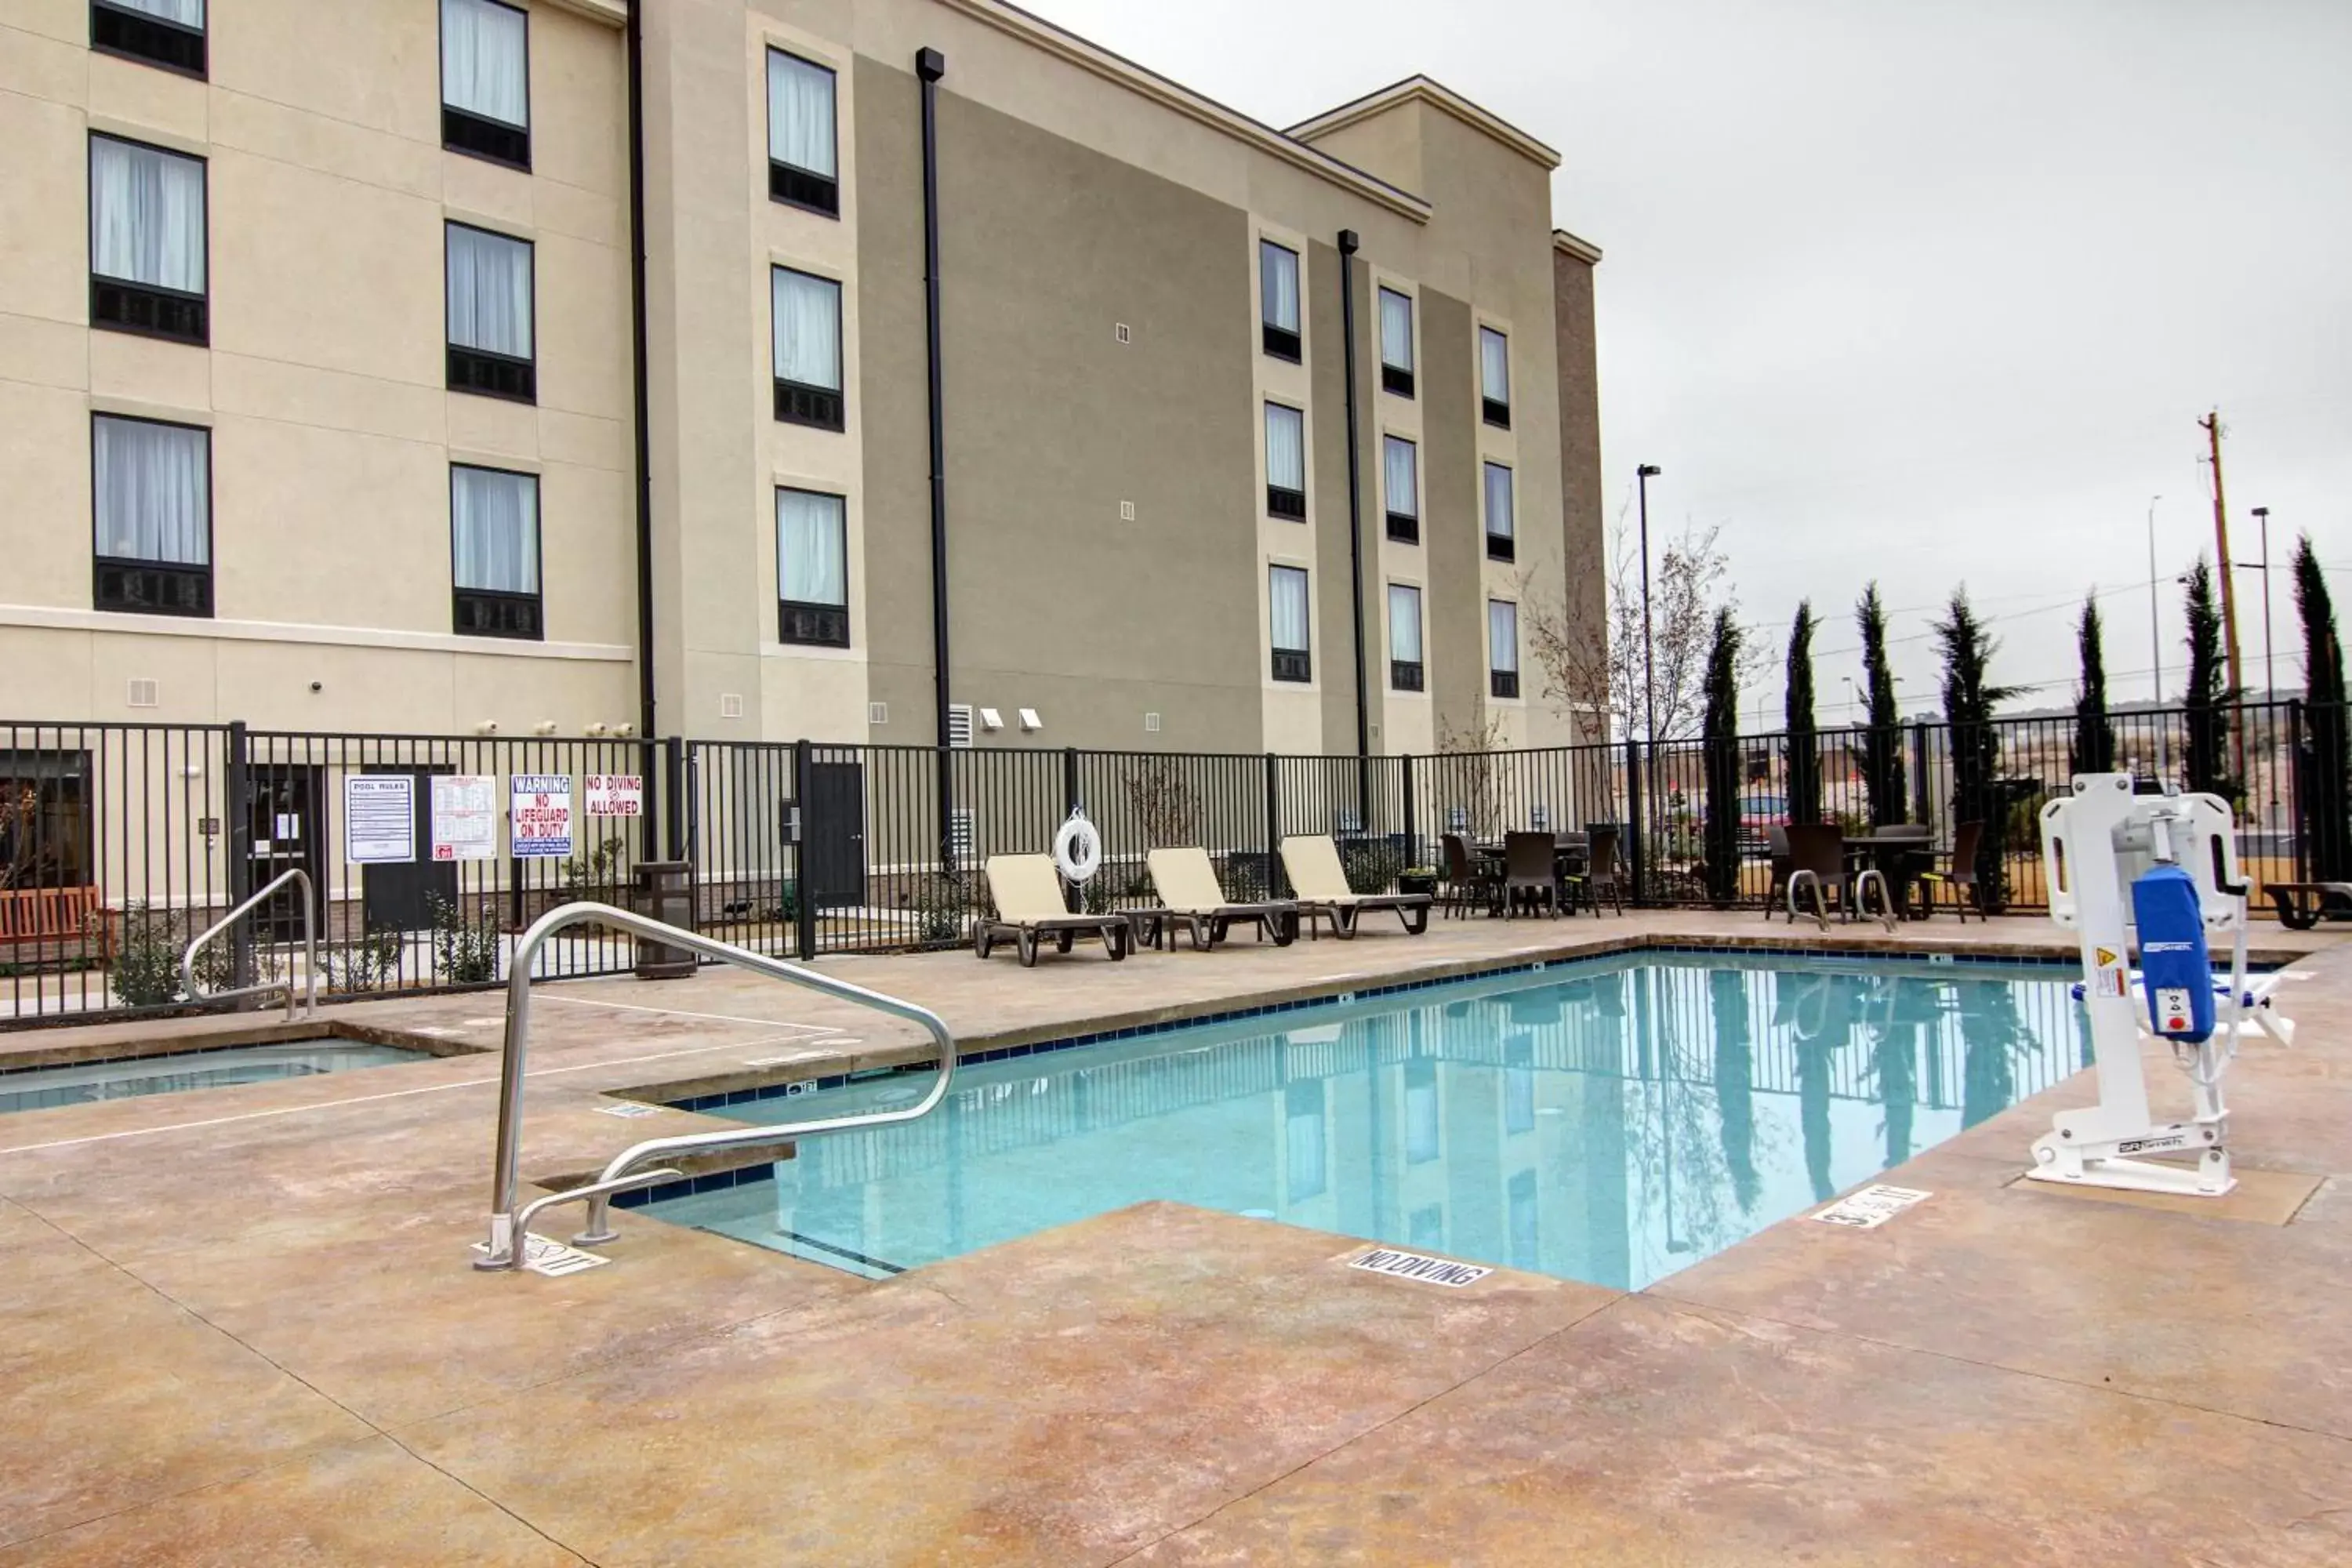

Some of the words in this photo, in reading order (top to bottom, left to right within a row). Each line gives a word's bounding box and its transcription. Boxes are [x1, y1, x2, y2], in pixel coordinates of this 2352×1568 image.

[514, 777, 569, 793] WARNING
[587, 776, 601, 791] NO
[607, 777, 641, 791] DIVING
[535, 794, 550, 808] NO
[590, 800, 638, 815] ALLOWED
[515, 808, 568, 822] LIFEGUARD
[521, 823, 534, 837] ON
[539, 823, 564, 837] DUTY
[1353, 1250, 1401, 1268] NO
[1386, 1256, 1483, 1285] DIVING
